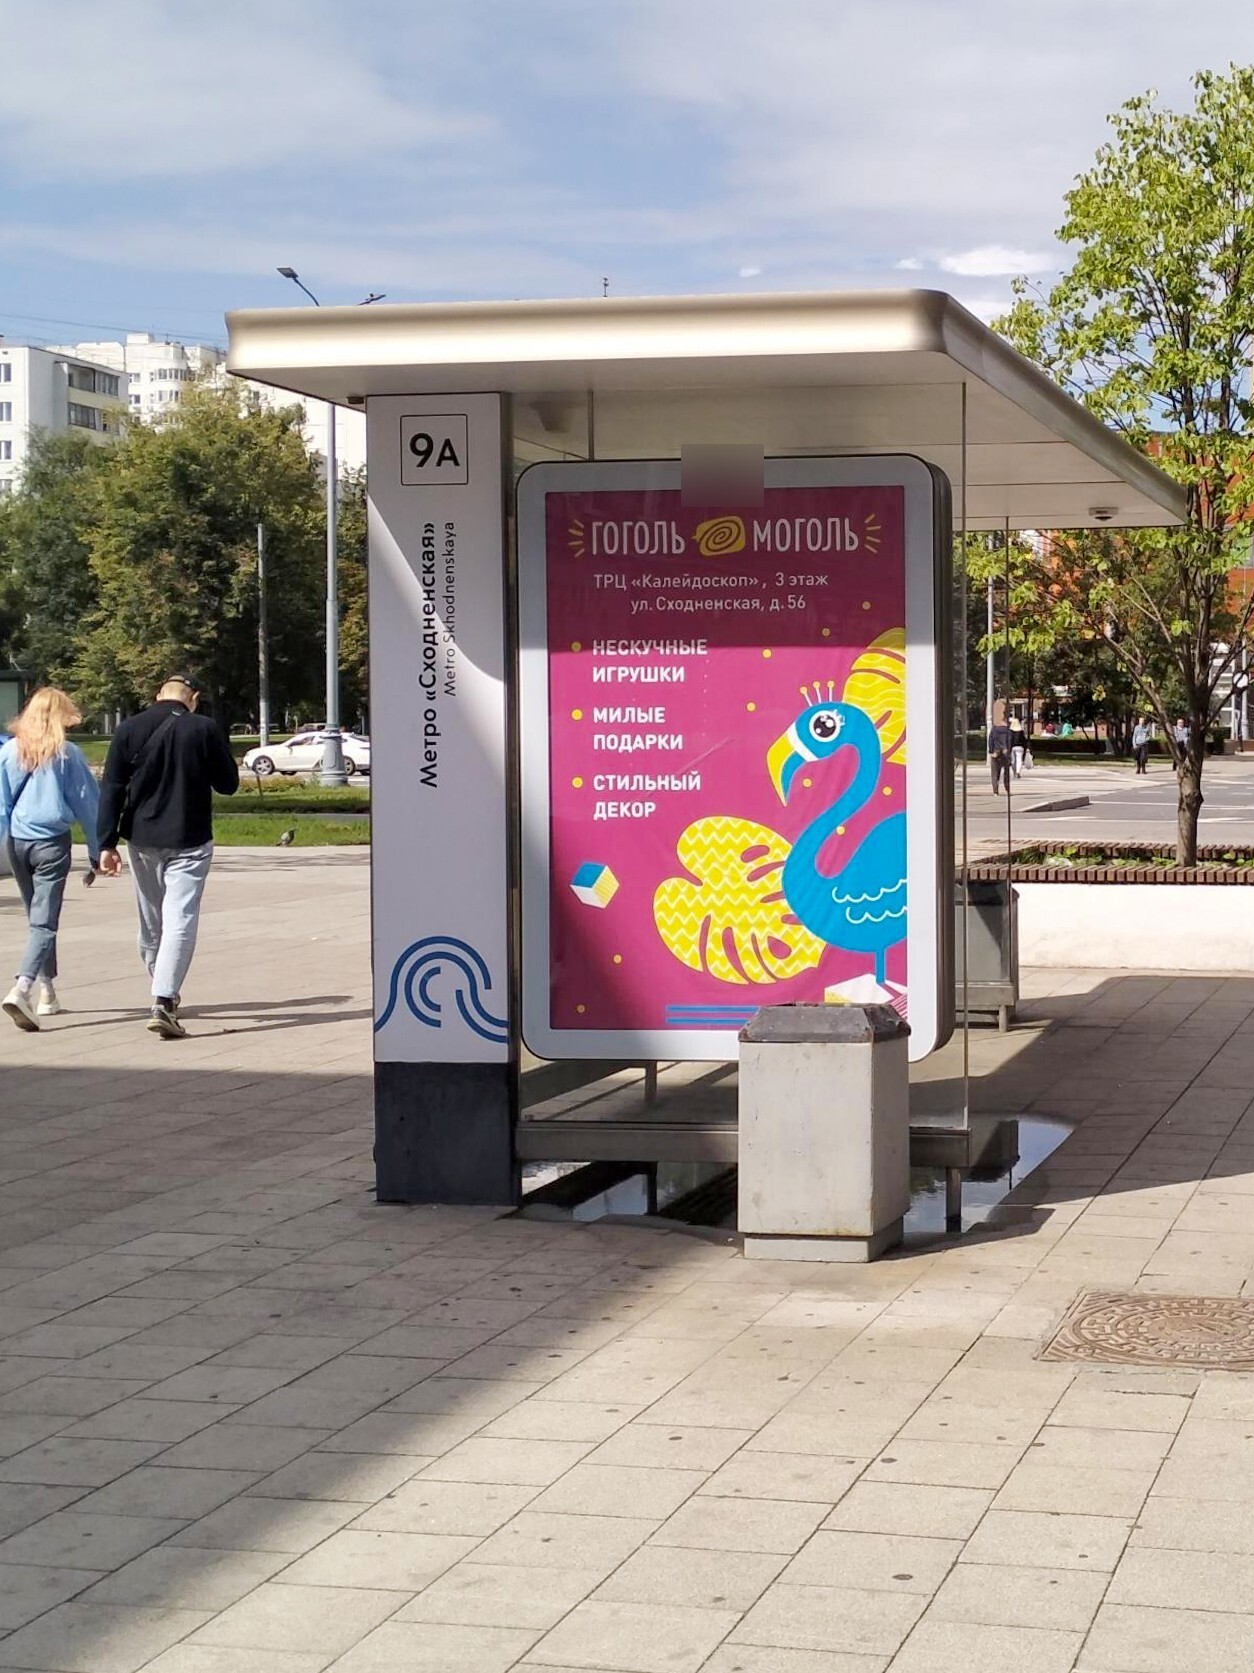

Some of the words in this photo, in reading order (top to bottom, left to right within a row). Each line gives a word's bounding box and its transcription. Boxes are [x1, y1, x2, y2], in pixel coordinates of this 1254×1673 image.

[409, 432, 461, 468] 9А
[592, 520, 686, 555] ГОГОЛЬ
[752, 517, 859, 552] МОГОЛЬ
[442, 521, 456, 643] Skhodnenskaya
[593, 574, 627, 591] ТРЦ
[774, 571, 785, 587] 3
[788, 574, 829, 587] этаж
[418, 522, 437, 702] «Сходненская»
[631, 597, 653, 615] ул.
[656, 595, 765, 612] Сходненская,
[787, 594, 806, 610] 56
[592, 639, 708, 656] НЕСКУЧНЫЕ
[443, 644, 457, 697] Metro
[592, 666, 685, 683] ИГРУШКИ
[592, 706, 666, 724] МИЛЫЕ
[418, 708, 441, 788] Метро
[592, 734, 683, 753] ПОДАРКИ
[592, 770, 701, 791] СТИЛЬНЫЙ
[592, 801, 657, 821] ДЕКОР
